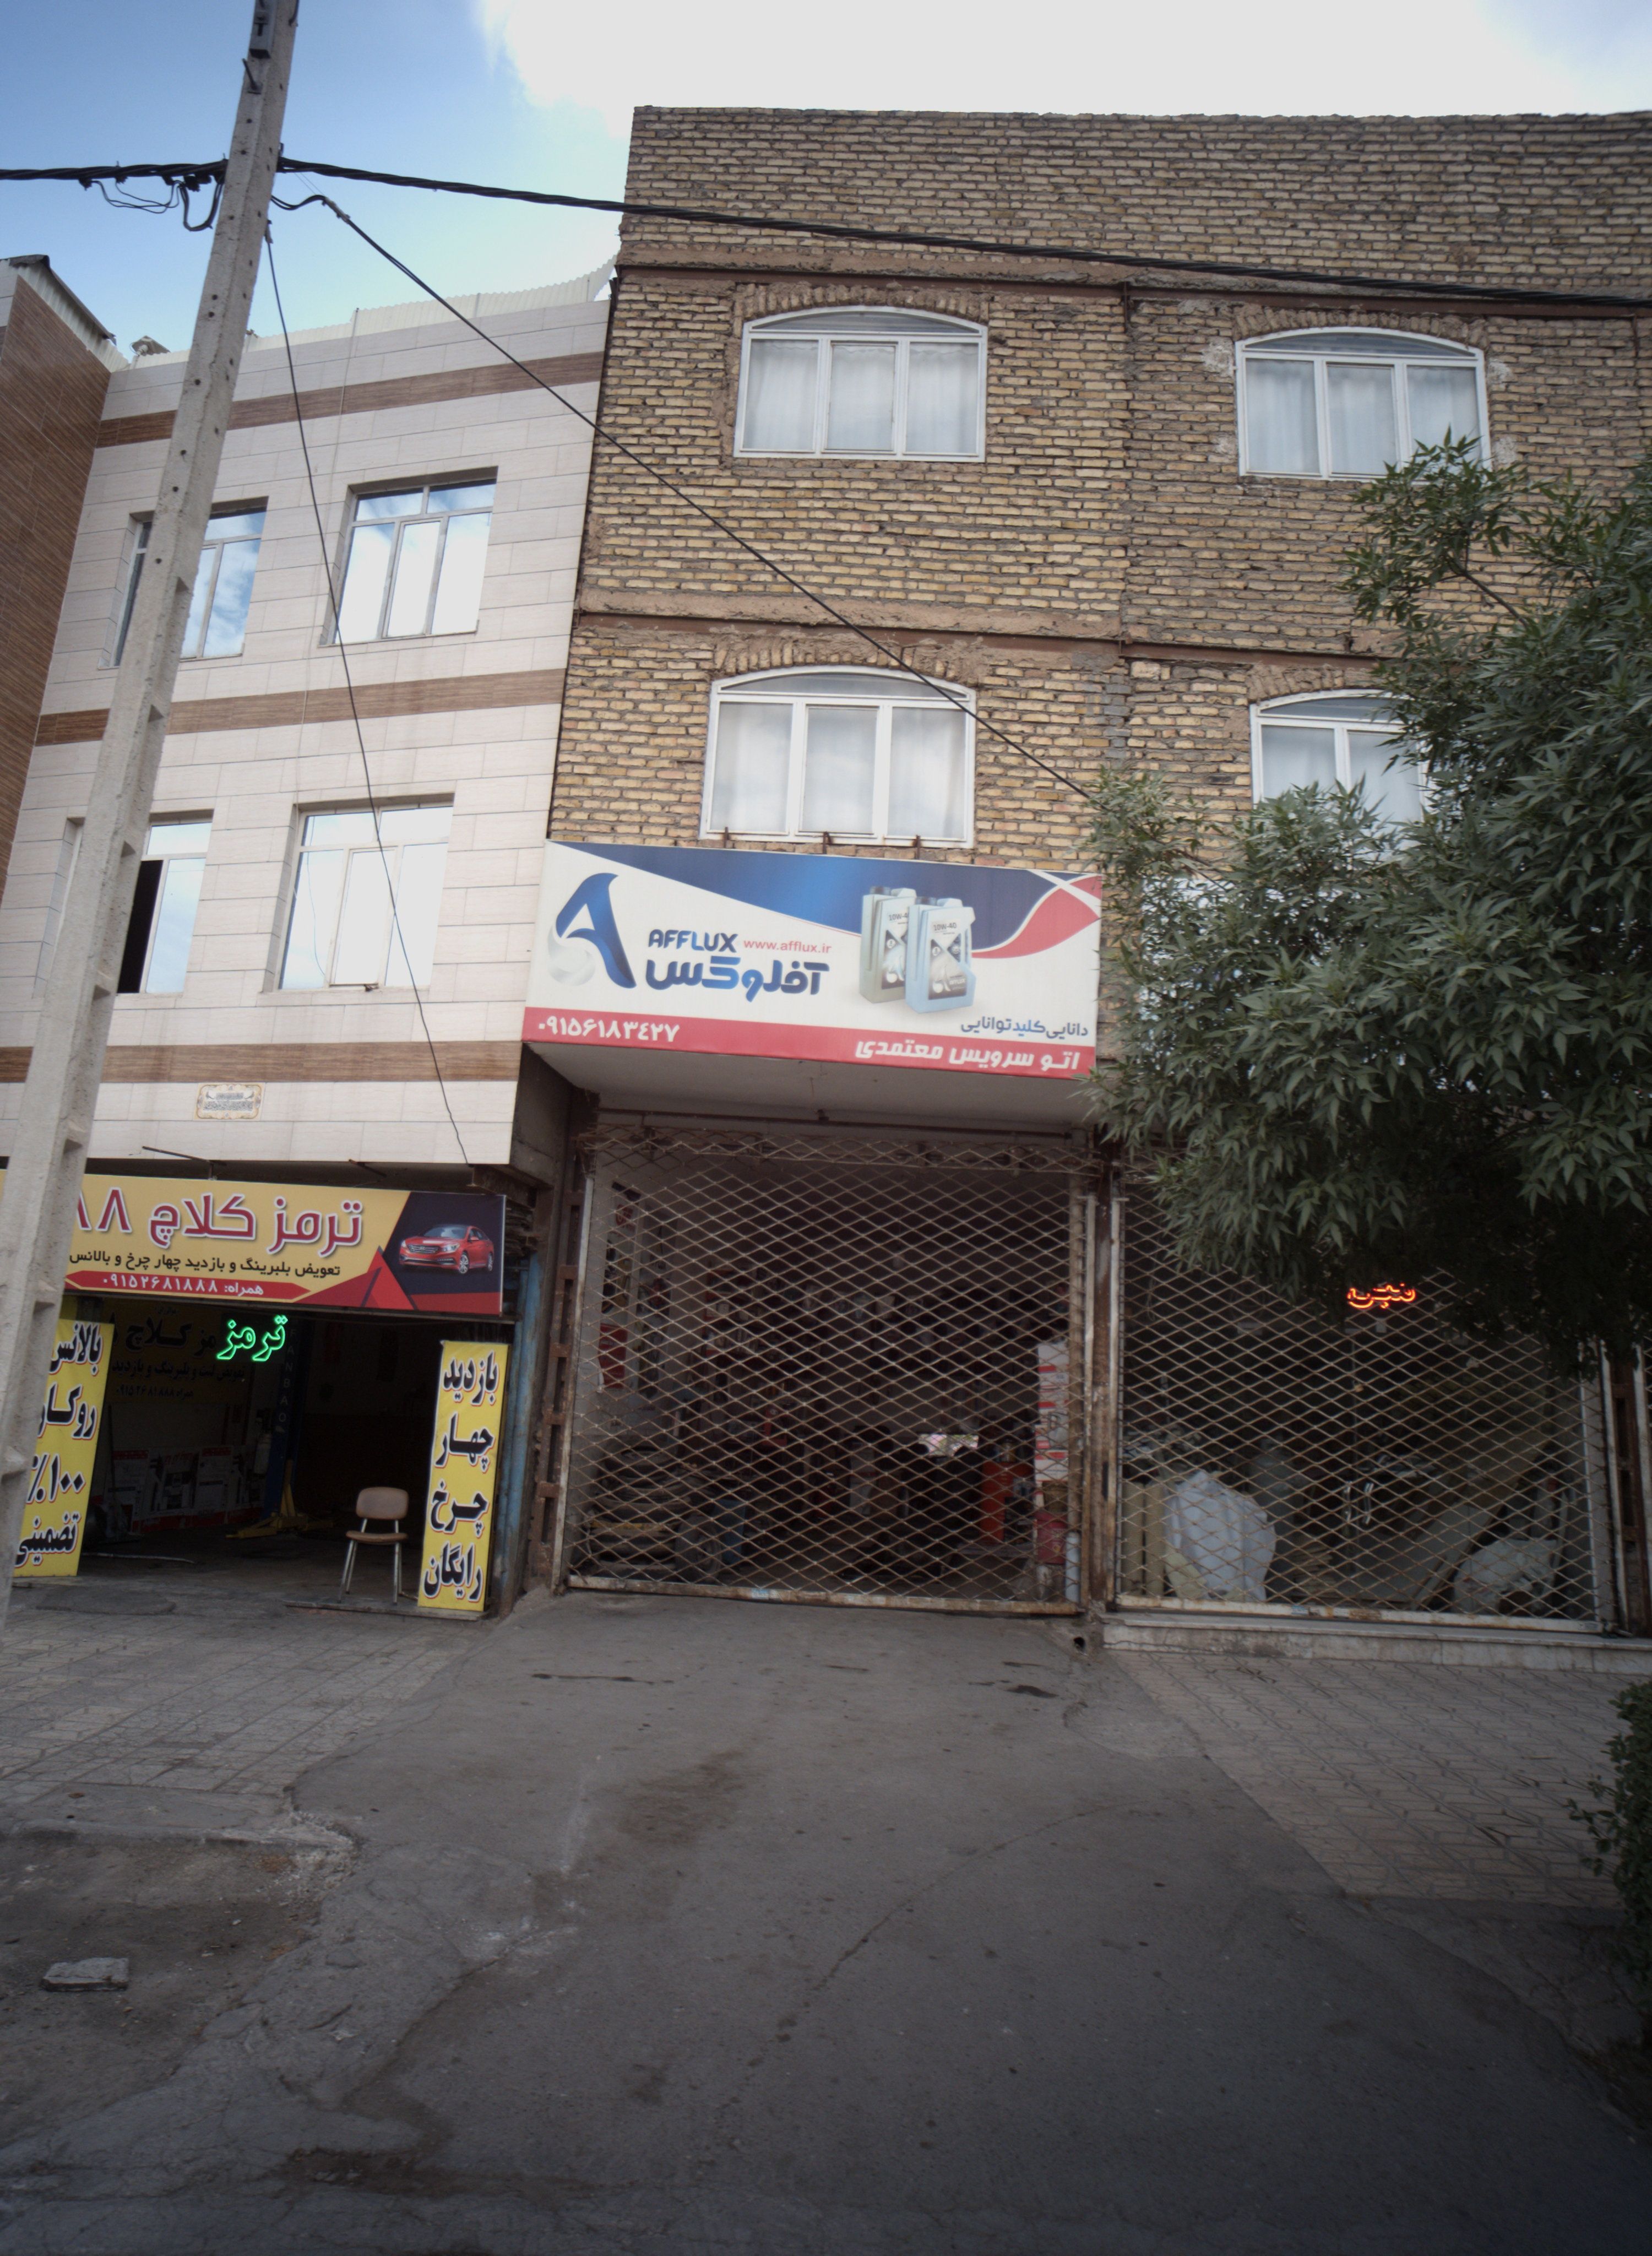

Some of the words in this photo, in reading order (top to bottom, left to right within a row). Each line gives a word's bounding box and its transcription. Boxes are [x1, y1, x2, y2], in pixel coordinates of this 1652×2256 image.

[934, 921, 957, 931] 10W-40
[648, 929, 738, 953] AFFLUX
[744, 939, 832, 954] www.afflux.ir
[645, 956, 830, 1002] آفلوکس
[961, 1016, 1012, 1033] توانایی
[1012, 1019, 1046, 1037] کلید
[1046, 1022, 1088, 1040] دانایی
[855, 1039, 943, 1059] معتمدی
[949, 1046, 1034, 1069] سرویس
[1040, 1051, 1080, 1072] اتو
[149, 1192, 257, 1249] کلاچ
[266, 1196, 363, 1258] ترمز
[69, 1251, 110, 1263] بالانس
[115, 1254, 121, 1265] و
[126, 1252, 150, 1270] چرخ
[154, 1254, 181, 1272] چهار
[186, 1257, 225, 1272] بازدید
[229, 1262, 236, 1272] و
[240, 1257, 290, 1276] بلبرینگ
[295, 1266, 340, 1278] تعویض
[215, 1314, 288, 1362] ترمز
[48, 1322, 102, 1376] بالانس
[443, 1350, 499, 1406] بازدید
[434, 1412, 494, 1473] چهار
[431, 1479, 489, 1538] چرخ
[14, 1512, 80, 1568] تضمینی
[423, 1541, 483, 1602] رایگان
